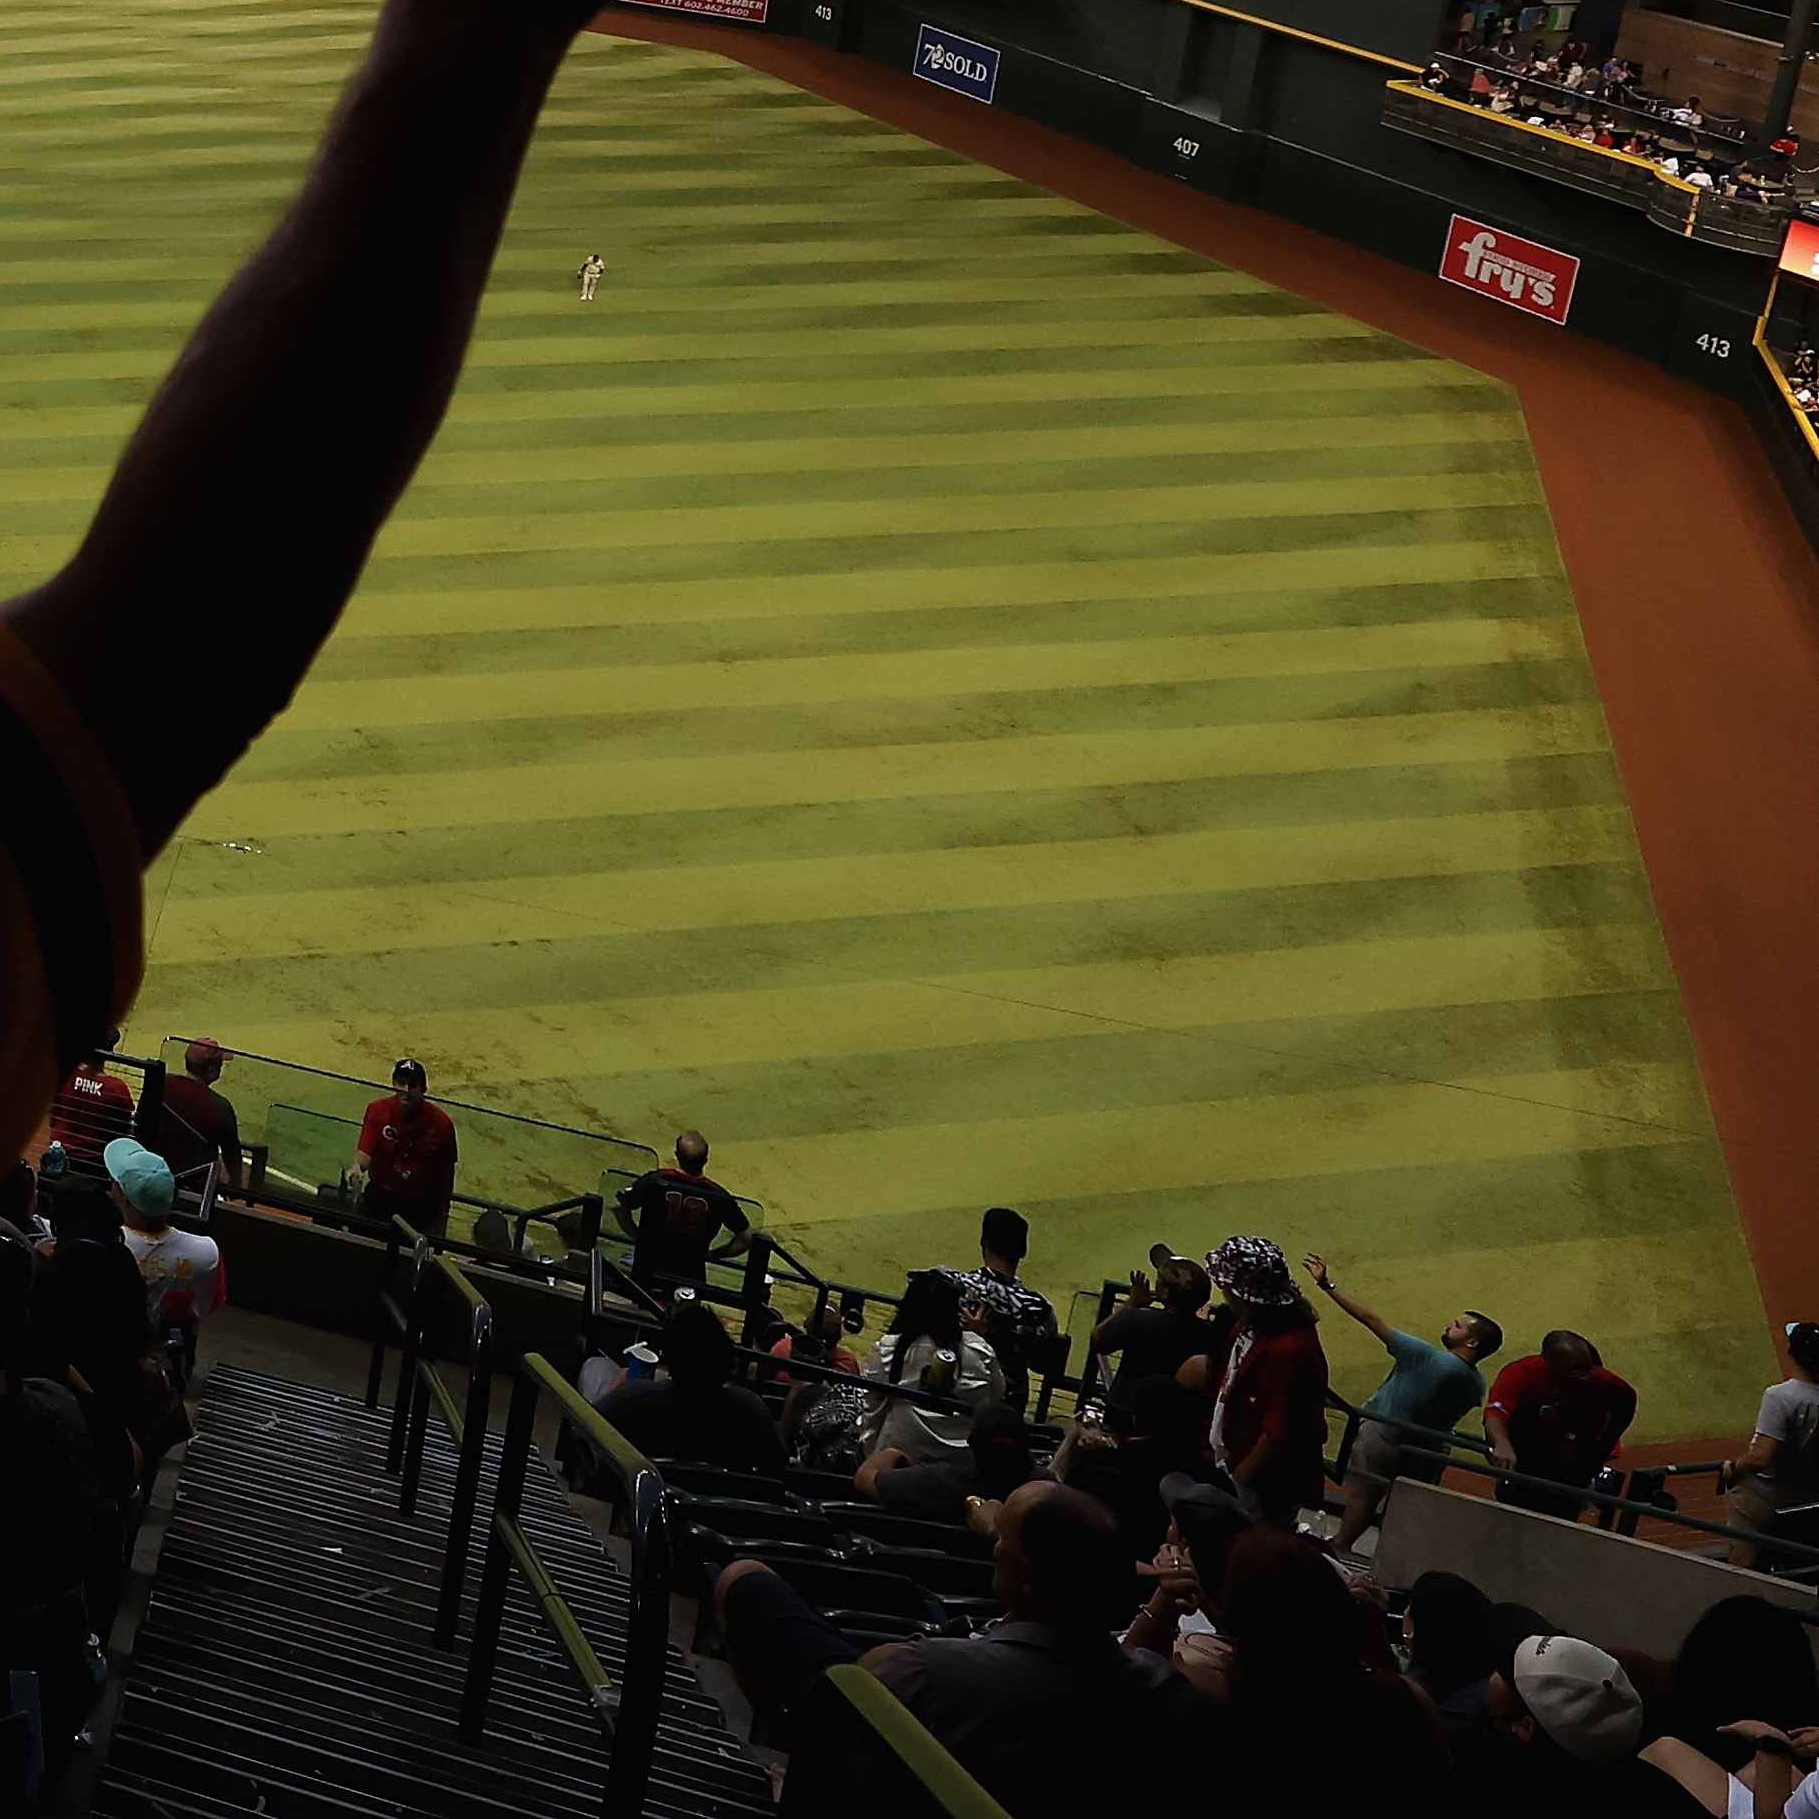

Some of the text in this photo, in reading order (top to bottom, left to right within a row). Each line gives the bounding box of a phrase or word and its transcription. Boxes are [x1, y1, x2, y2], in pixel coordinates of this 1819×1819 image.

[815, 4, 834, 22] 413
[1173, 137, 1201, 158] 407
[1458, 231, 1556, 308] fry's
[1694, 333, 1731, 359] 413
[74, 1077, 104, 1097] PINK
